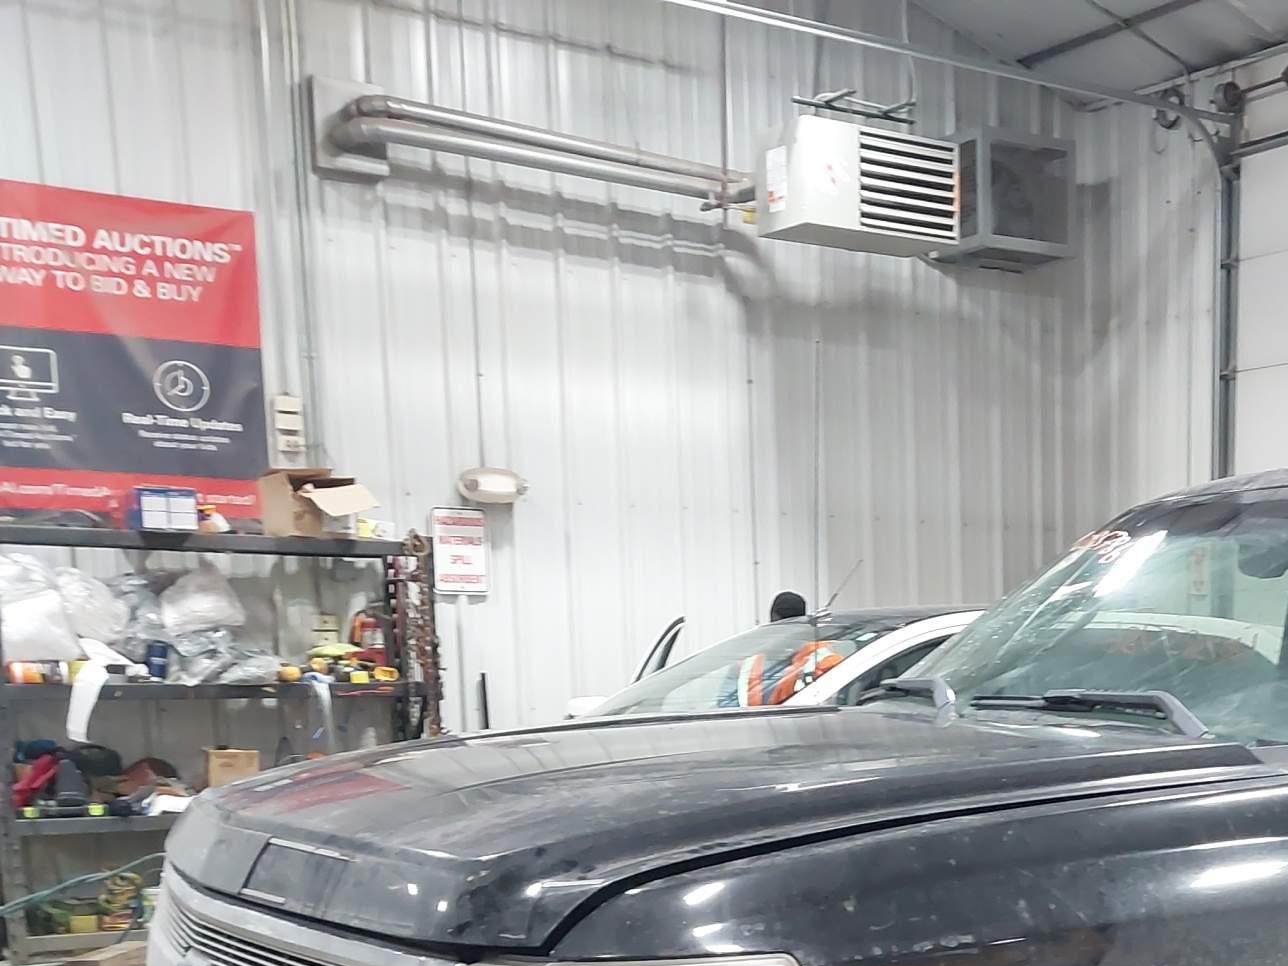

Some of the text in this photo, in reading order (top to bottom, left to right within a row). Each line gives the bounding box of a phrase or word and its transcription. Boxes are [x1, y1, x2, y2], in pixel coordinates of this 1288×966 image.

[0, 216, 86, 247] TIMED
[50, 270, 85, 292] TO
[90, 275, 128, 296] BID
[132, 279, 152, 299] &
[156, 282, 203, 302] BUY
[141, 260, 159, 277] A
[164, 263, 216, 283] NEW
